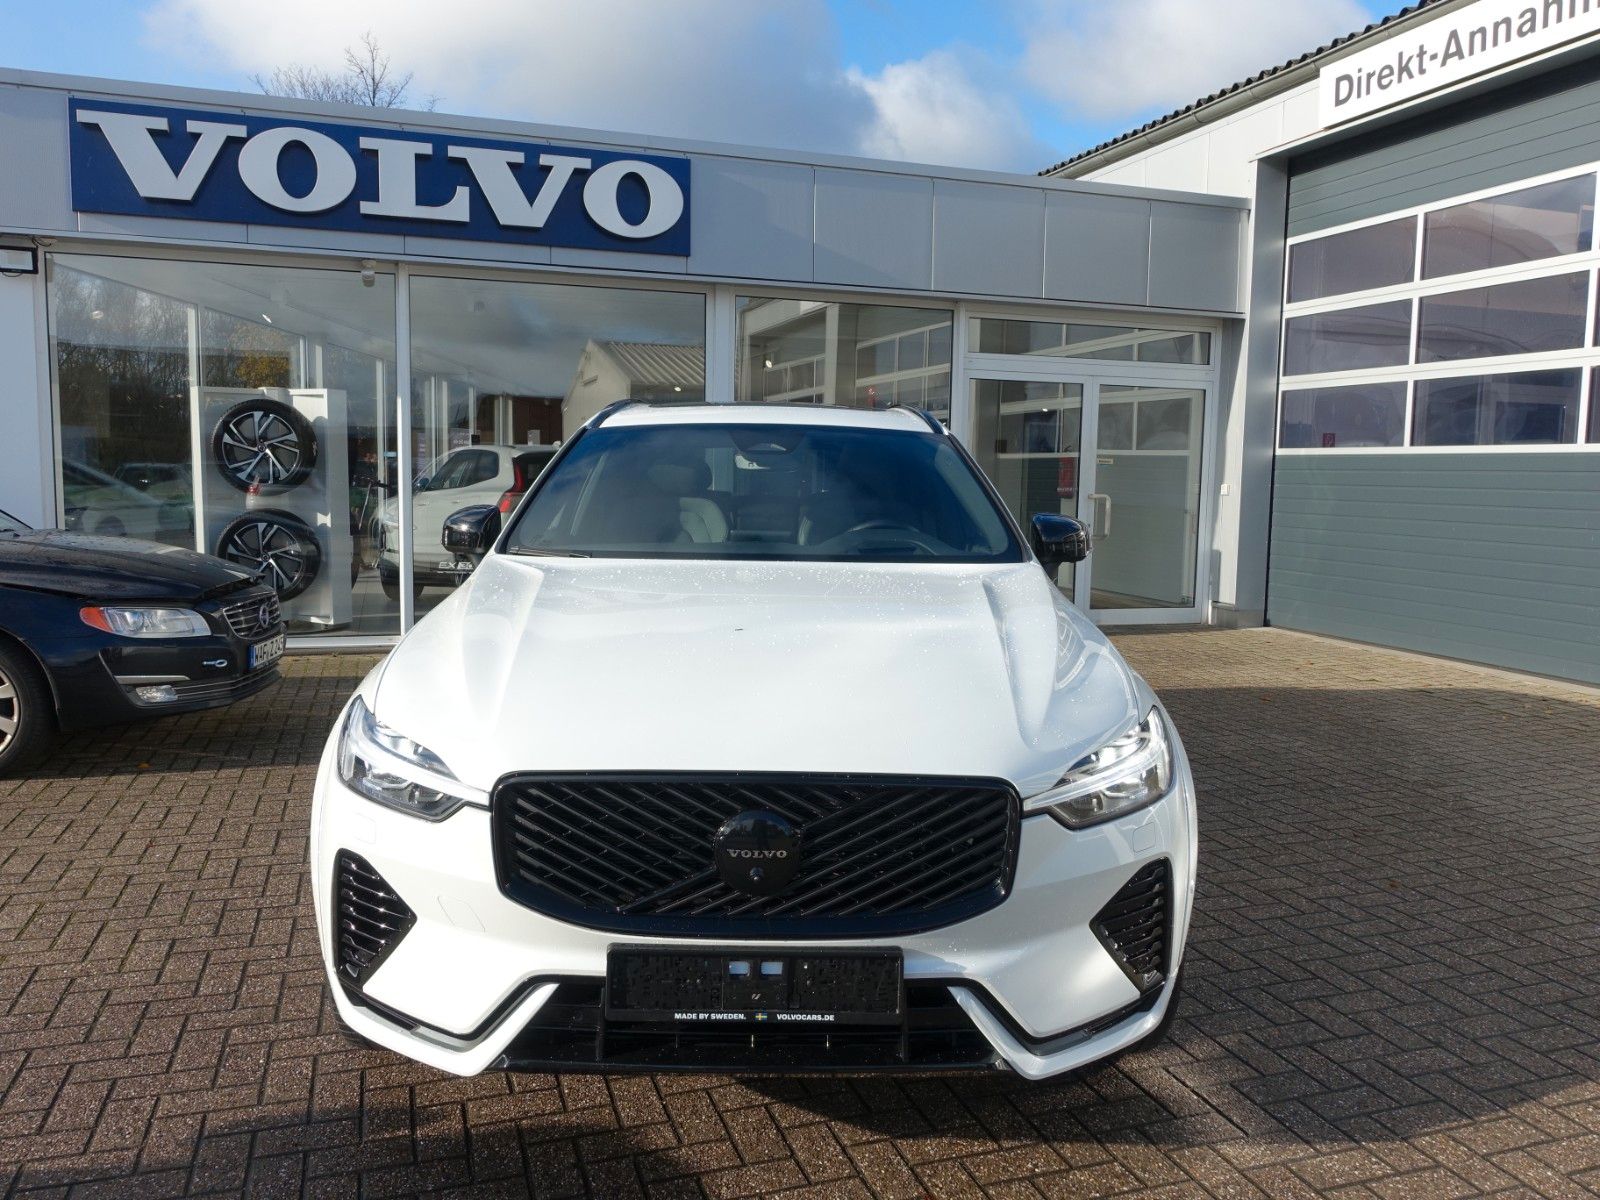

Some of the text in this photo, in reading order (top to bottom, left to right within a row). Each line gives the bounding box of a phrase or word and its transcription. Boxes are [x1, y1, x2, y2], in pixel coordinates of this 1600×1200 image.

[76, 109, 684, 239] VOLVO
[726, 848, 788, 859] VOLVO
[674, 1012, 835, 1021] MADE BY SWEDEN. VOLVOCARS.DE
